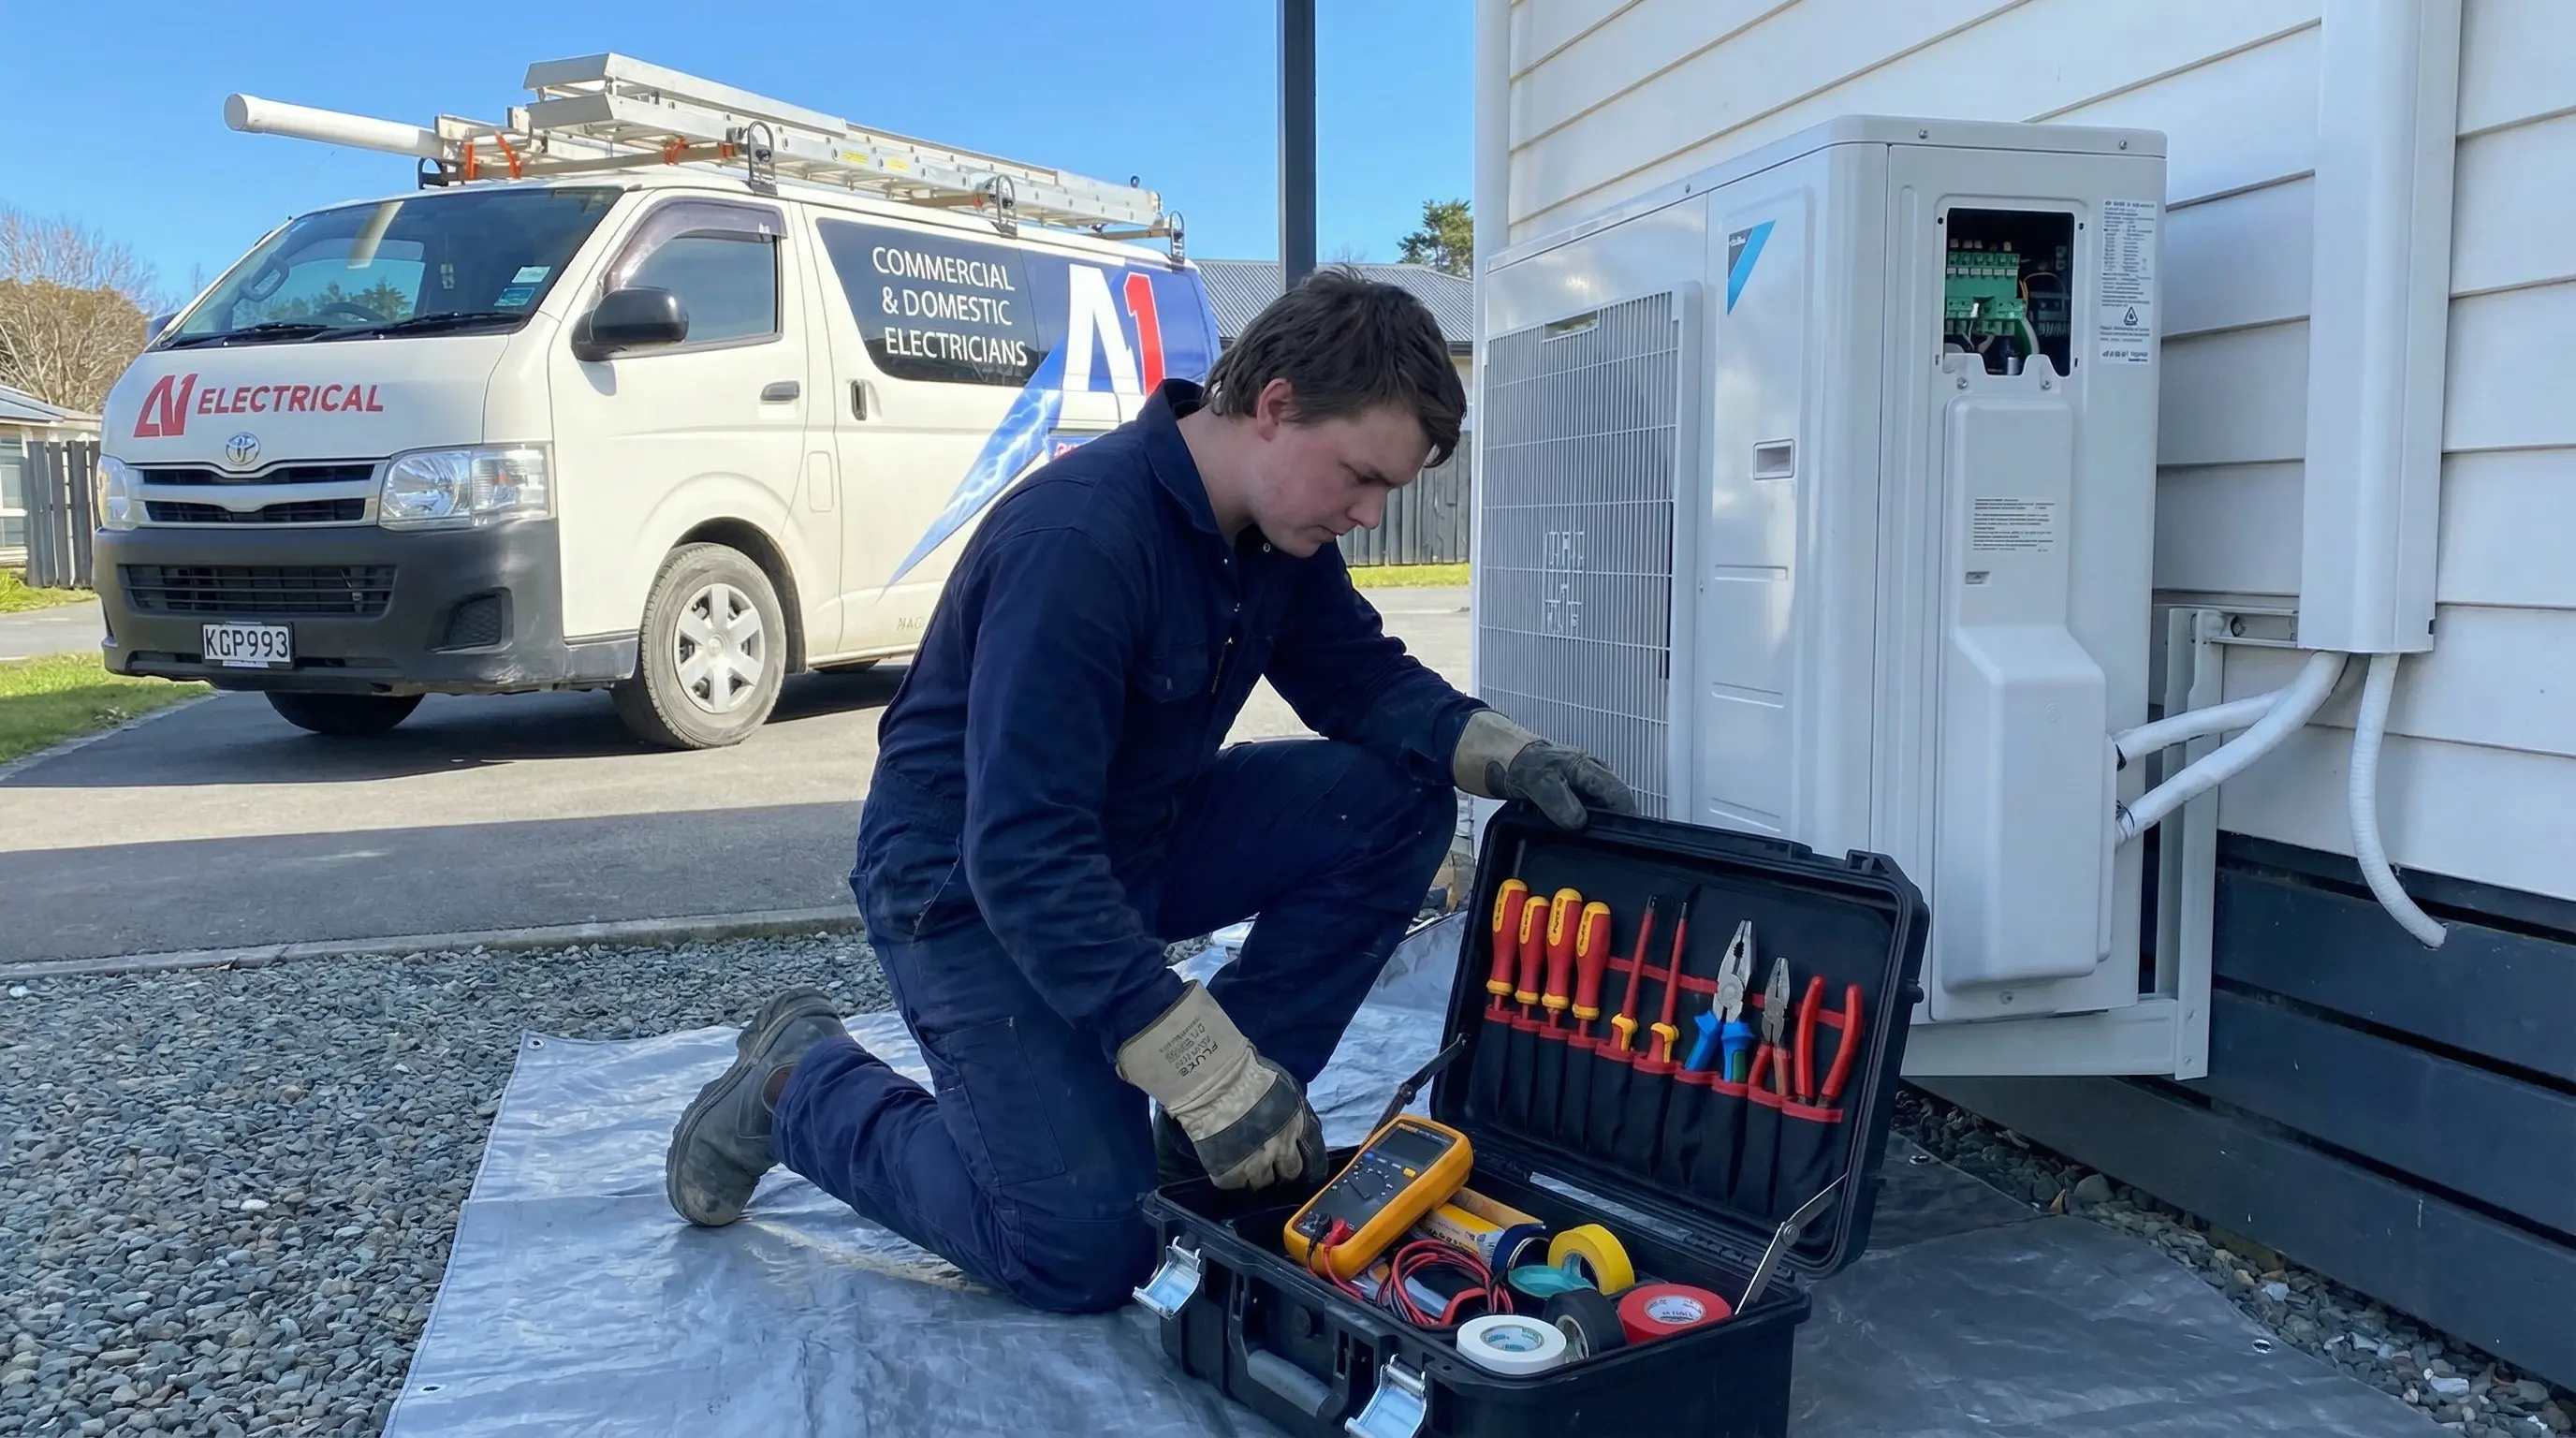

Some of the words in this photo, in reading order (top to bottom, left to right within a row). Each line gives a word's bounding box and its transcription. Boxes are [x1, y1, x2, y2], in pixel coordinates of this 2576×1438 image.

[872, 247, 1015, 291] COMMERCIAL
[882, 286, 899, 315] &
[904, 291, 1013, 326] DOMESTIC
[885, 327, 1028, 366] ELECTRICIANS
[1058, 263, 1166, 426] A1
[198, 384, 384, 414] ELECTRICAL
[205, 628, 288, 658] KGP993
[1178, 1040, 1218, 1077] FLUKE
